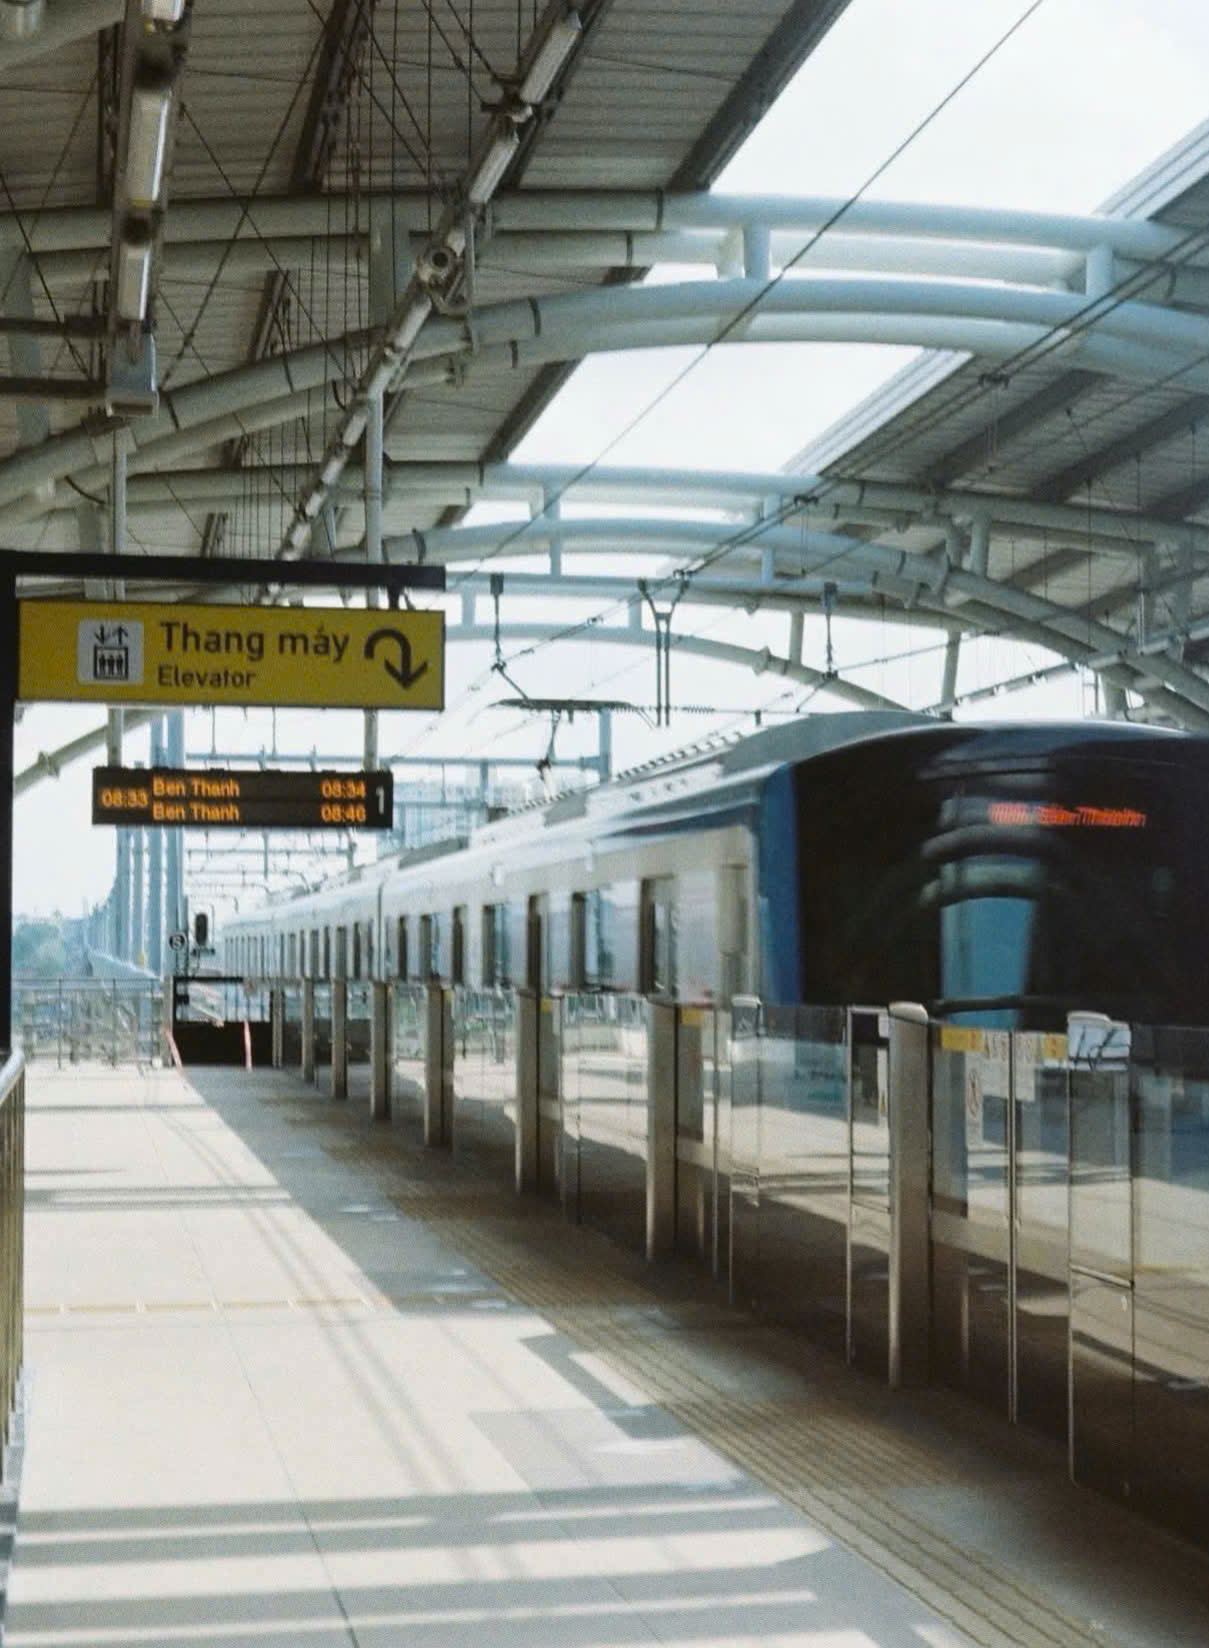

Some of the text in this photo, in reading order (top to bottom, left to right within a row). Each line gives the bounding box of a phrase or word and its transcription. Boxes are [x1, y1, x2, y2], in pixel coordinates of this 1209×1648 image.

[160, 620, 350, 664] Thang máy
[157, 664, 257, 688] Elevator
[376, 786, 385, 815] 1
